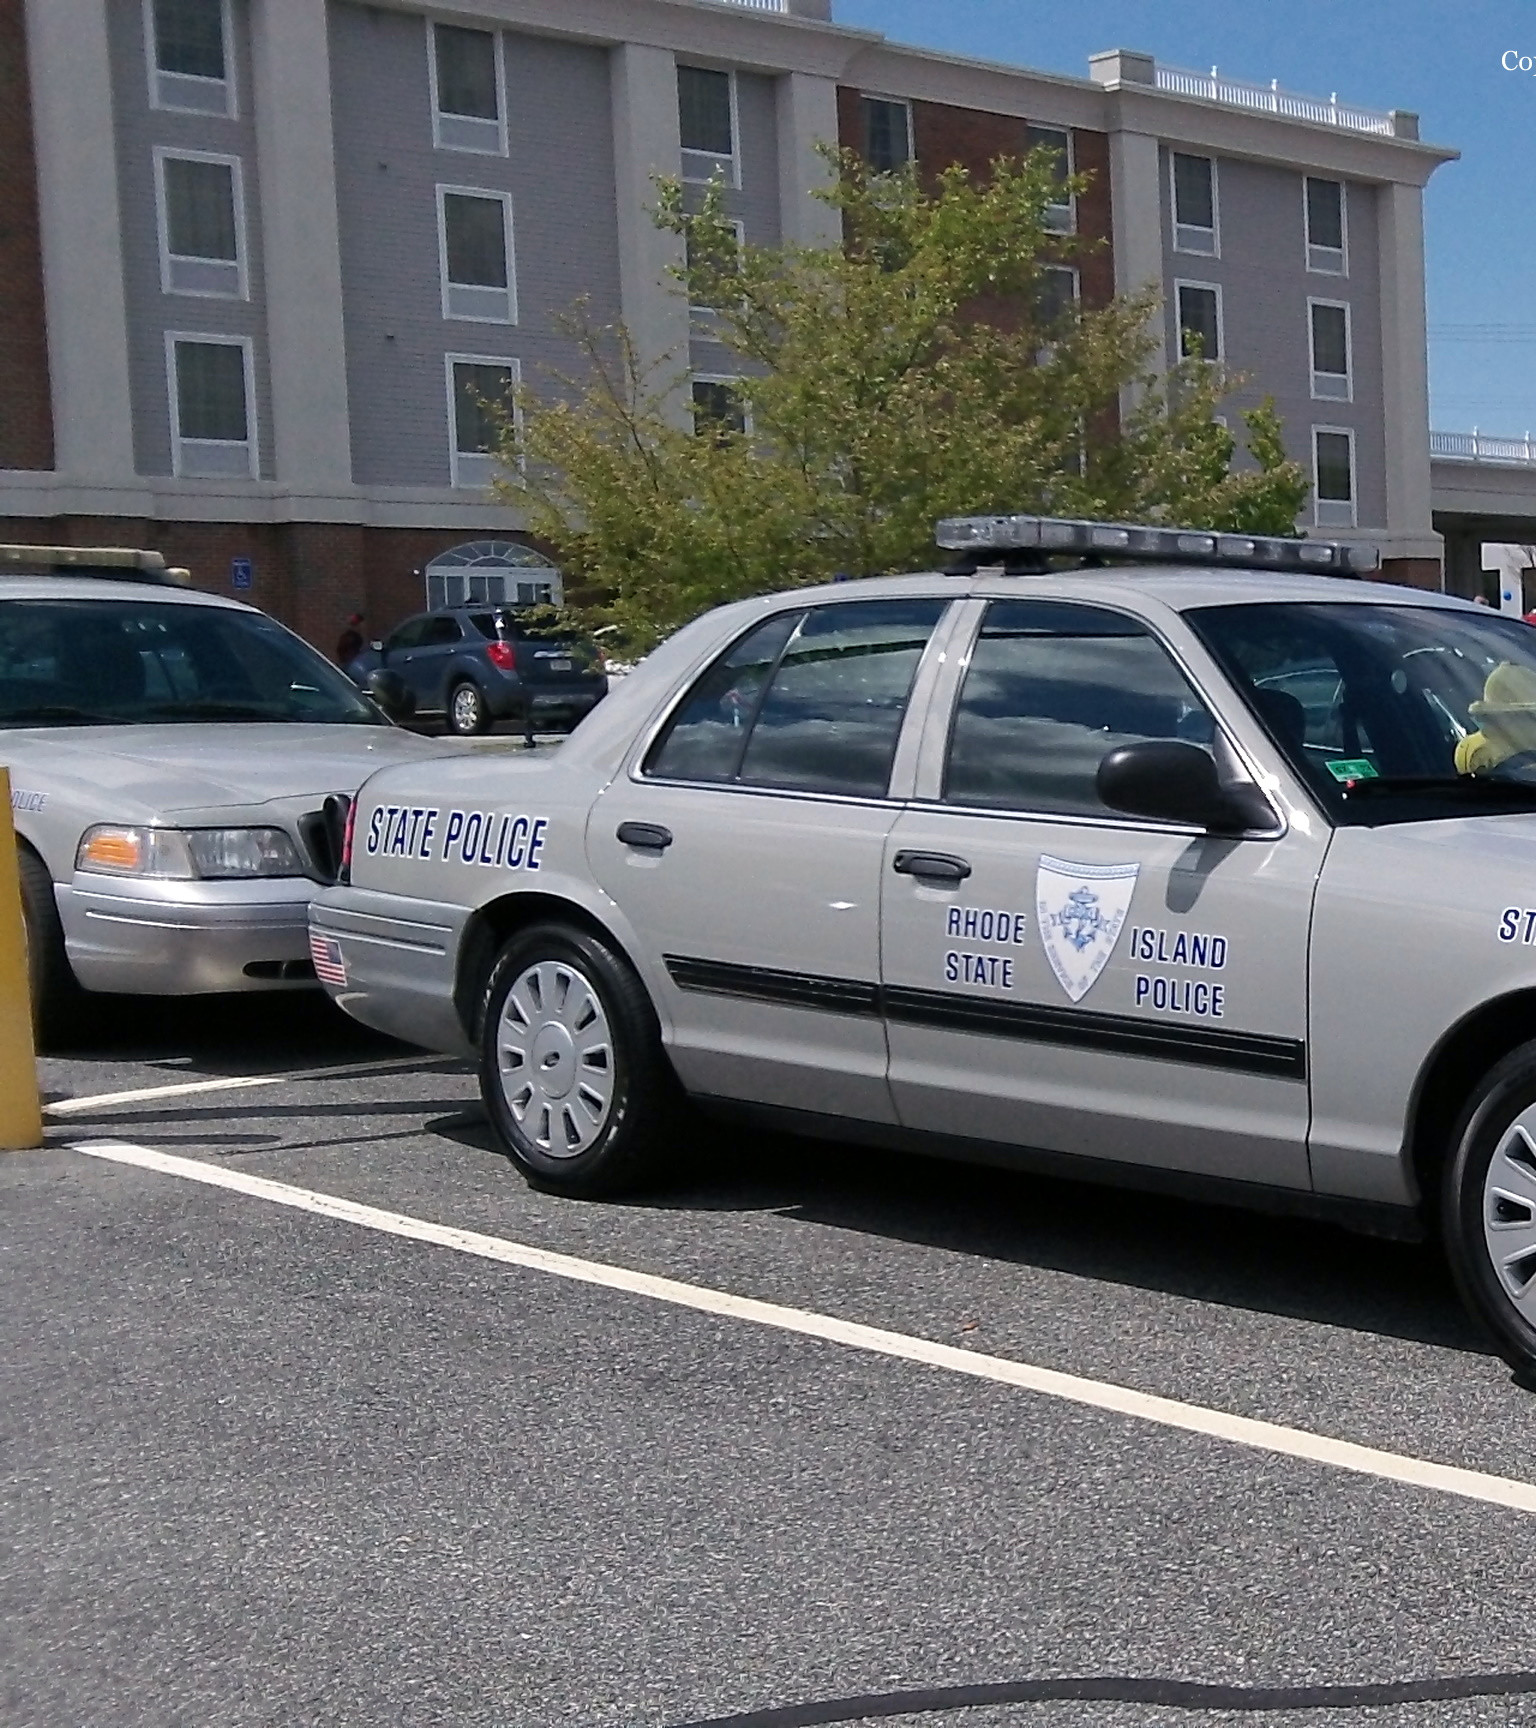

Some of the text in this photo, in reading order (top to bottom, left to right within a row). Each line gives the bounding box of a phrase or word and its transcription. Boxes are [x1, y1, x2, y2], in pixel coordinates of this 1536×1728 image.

[367, 805, 549, 872] STATE POLICE
[946, 907, 1026, 946] RHODE
[1131, 927, 1228, 969] ISLAND
[944, 951, 1225, 1018] STATE POLICE
